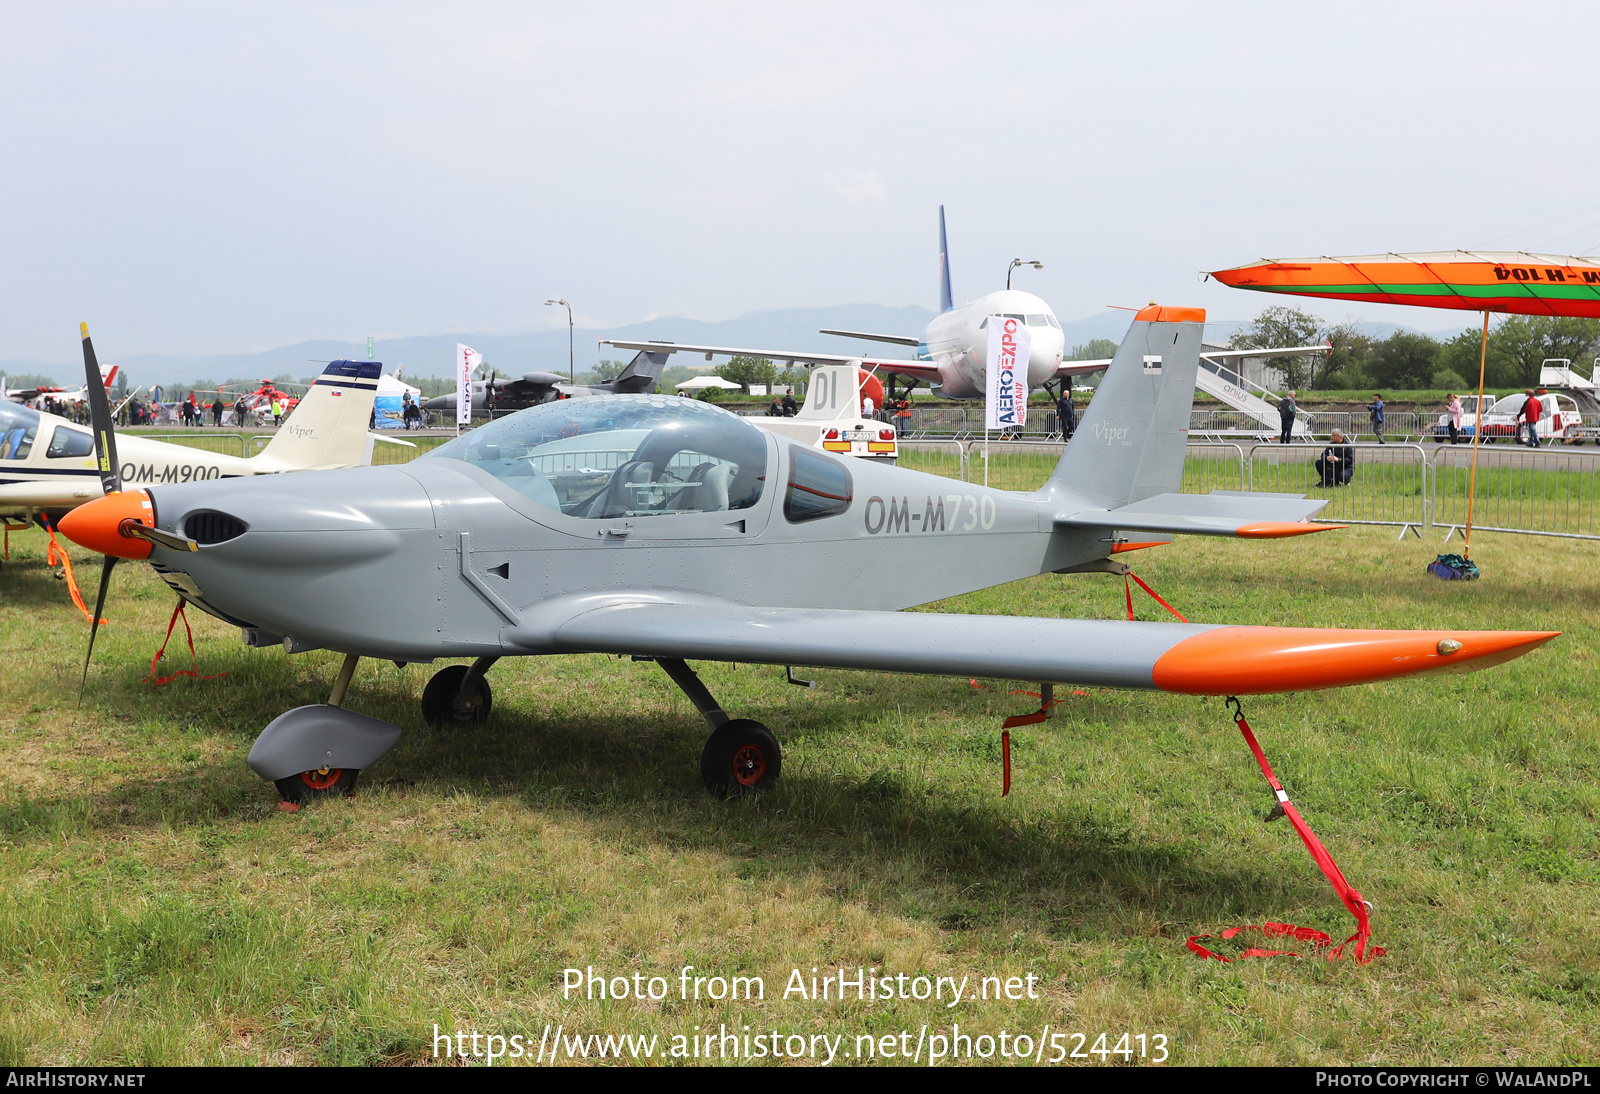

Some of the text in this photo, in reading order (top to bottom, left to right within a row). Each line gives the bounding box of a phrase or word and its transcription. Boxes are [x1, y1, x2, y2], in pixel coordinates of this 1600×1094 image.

[999, 319, 1017, 423] AEROEXPO
[813, 370, 837, 411] DI
[287, 424, 315, 439] Viper
[1091, 420, 1130, 446] Viper
[120, 462, 220, 484] OM-M900
[864, 494, 997, 535] OM-M730
